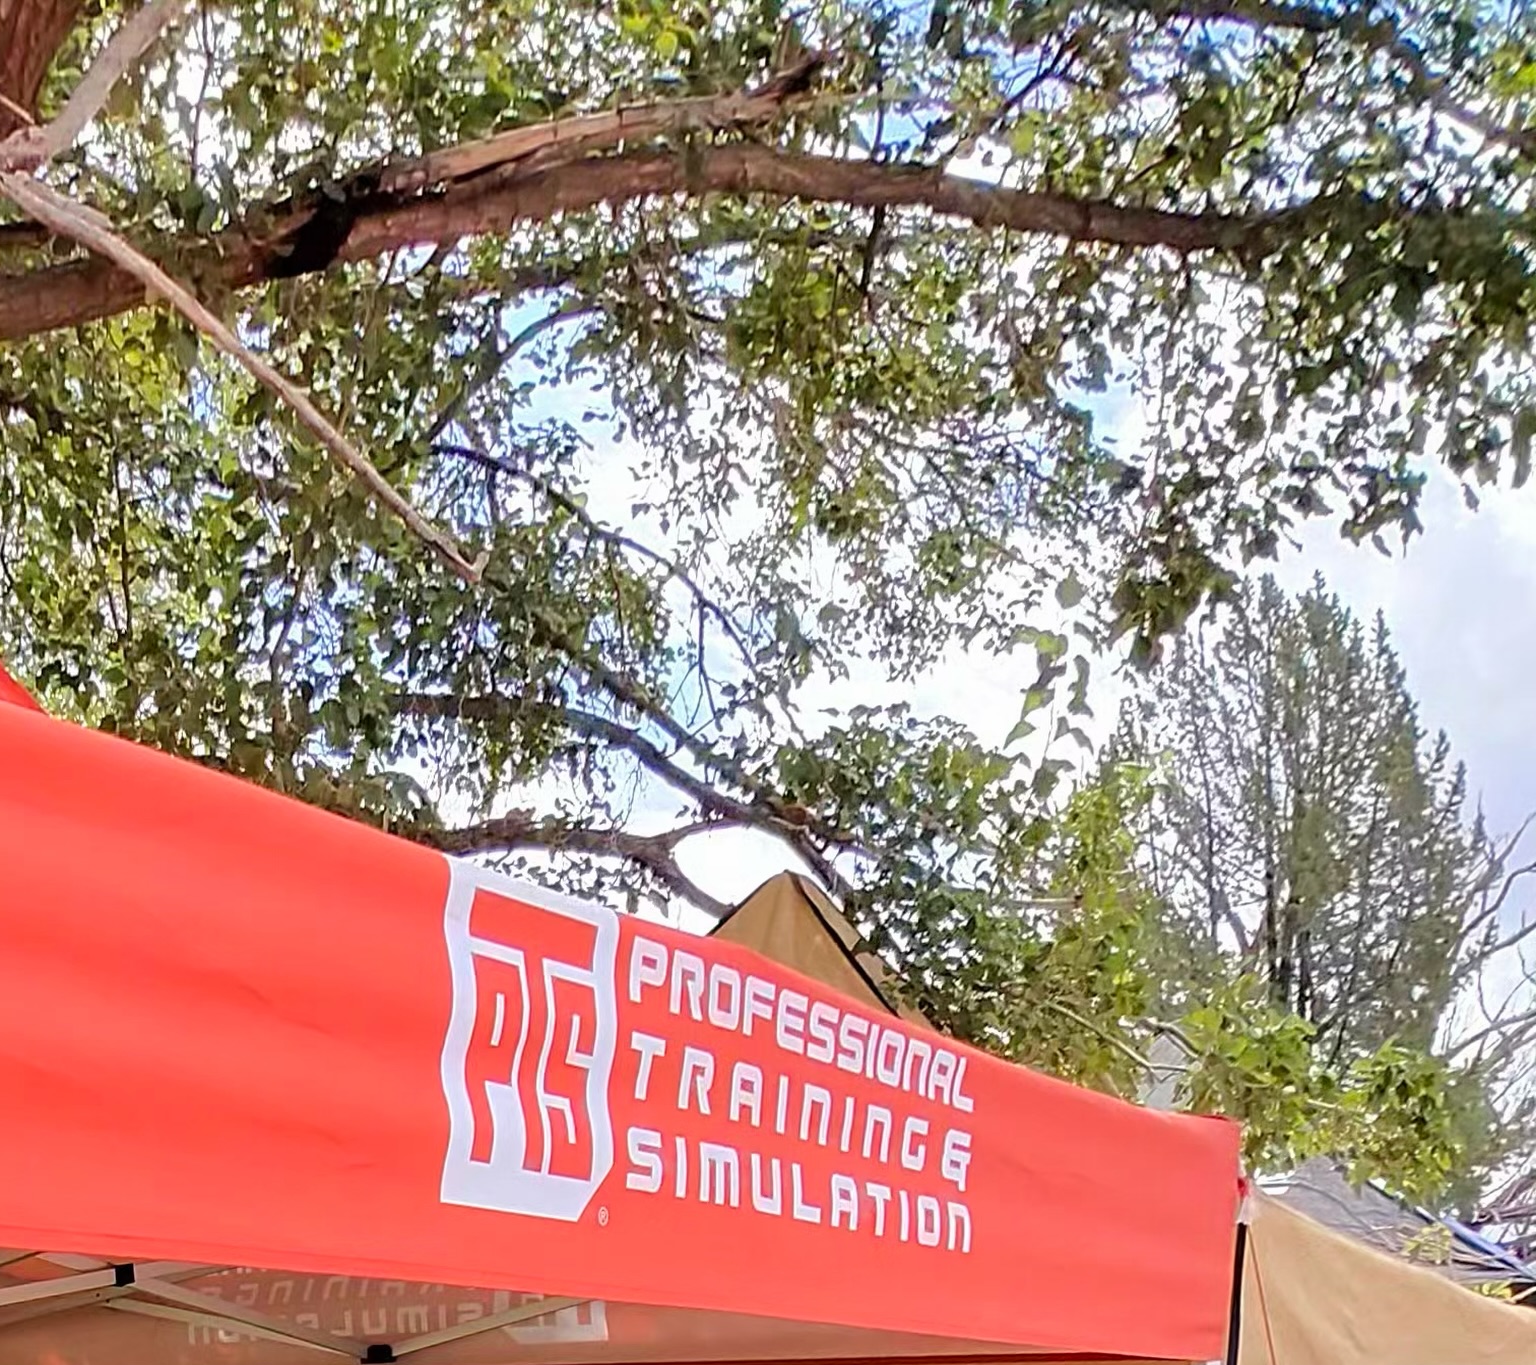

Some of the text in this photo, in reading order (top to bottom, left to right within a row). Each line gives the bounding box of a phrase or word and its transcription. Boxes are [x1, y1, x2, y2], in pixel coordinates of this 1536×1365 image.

[630, 937, 975, 1112] PROFESSIONAL
[632, 1033, 930, 1172] TRAINING
[626, 1127, 971, 1253] SIMULATION
